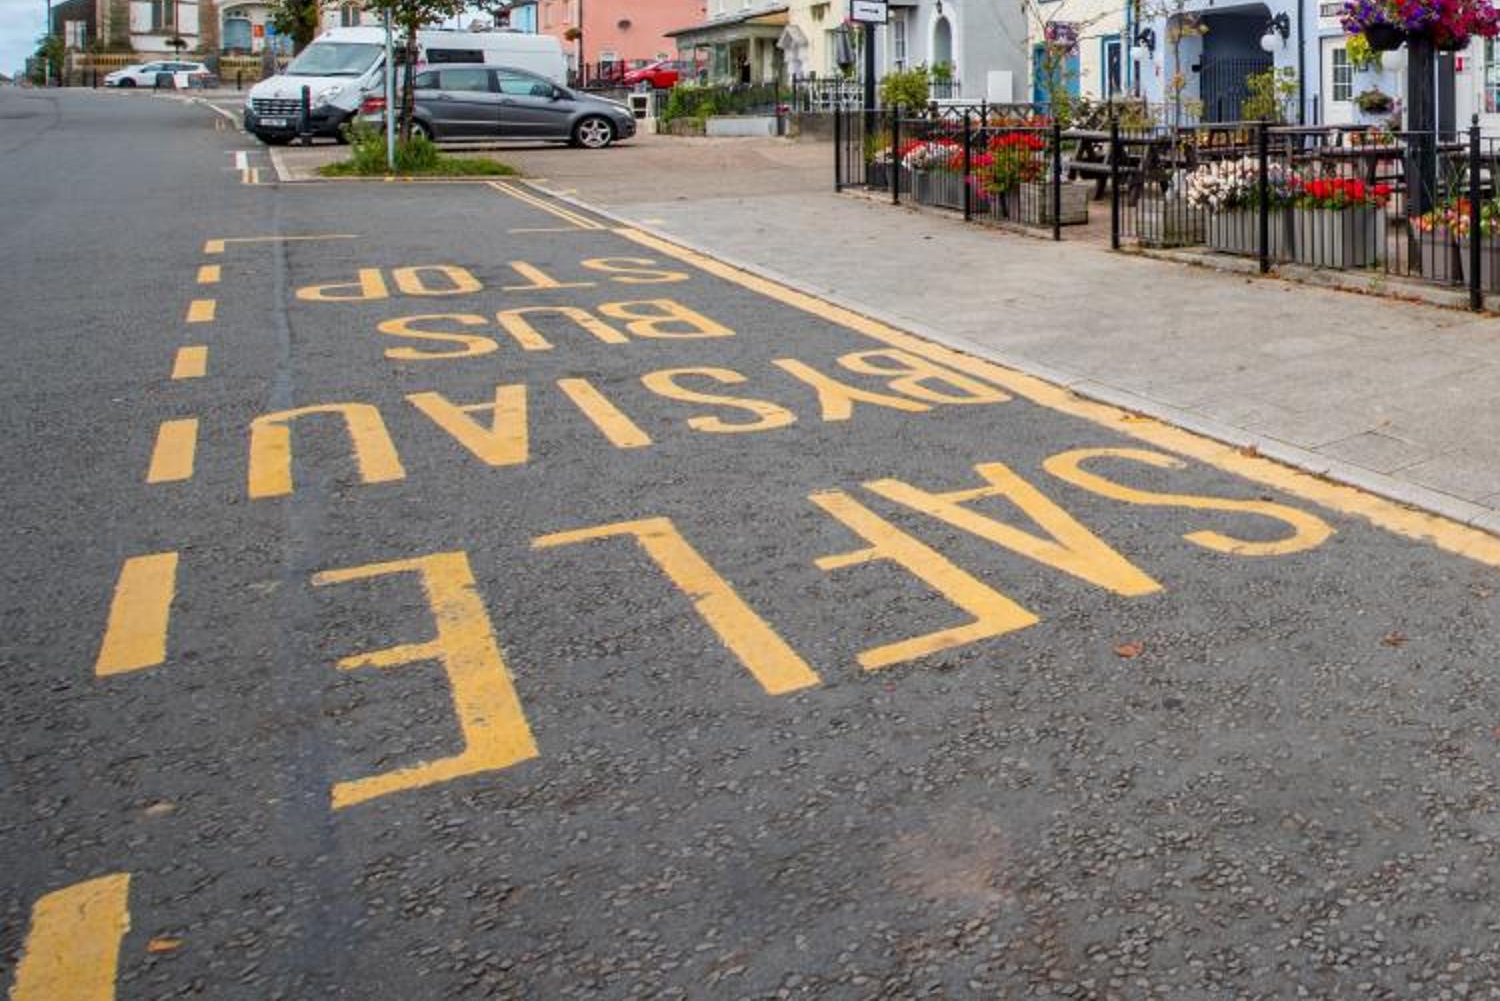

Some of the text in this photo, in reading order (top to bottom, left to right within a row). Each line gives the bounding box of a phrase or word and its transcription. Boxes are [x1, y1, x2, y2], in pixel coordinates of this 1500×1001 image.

[296, 257, 690, 301] STOP
[376, 298, 737, 360] BUS
[247, 347, 1014, 500] BYSIAU
[310, 445, 1337, 810] SAFLE
